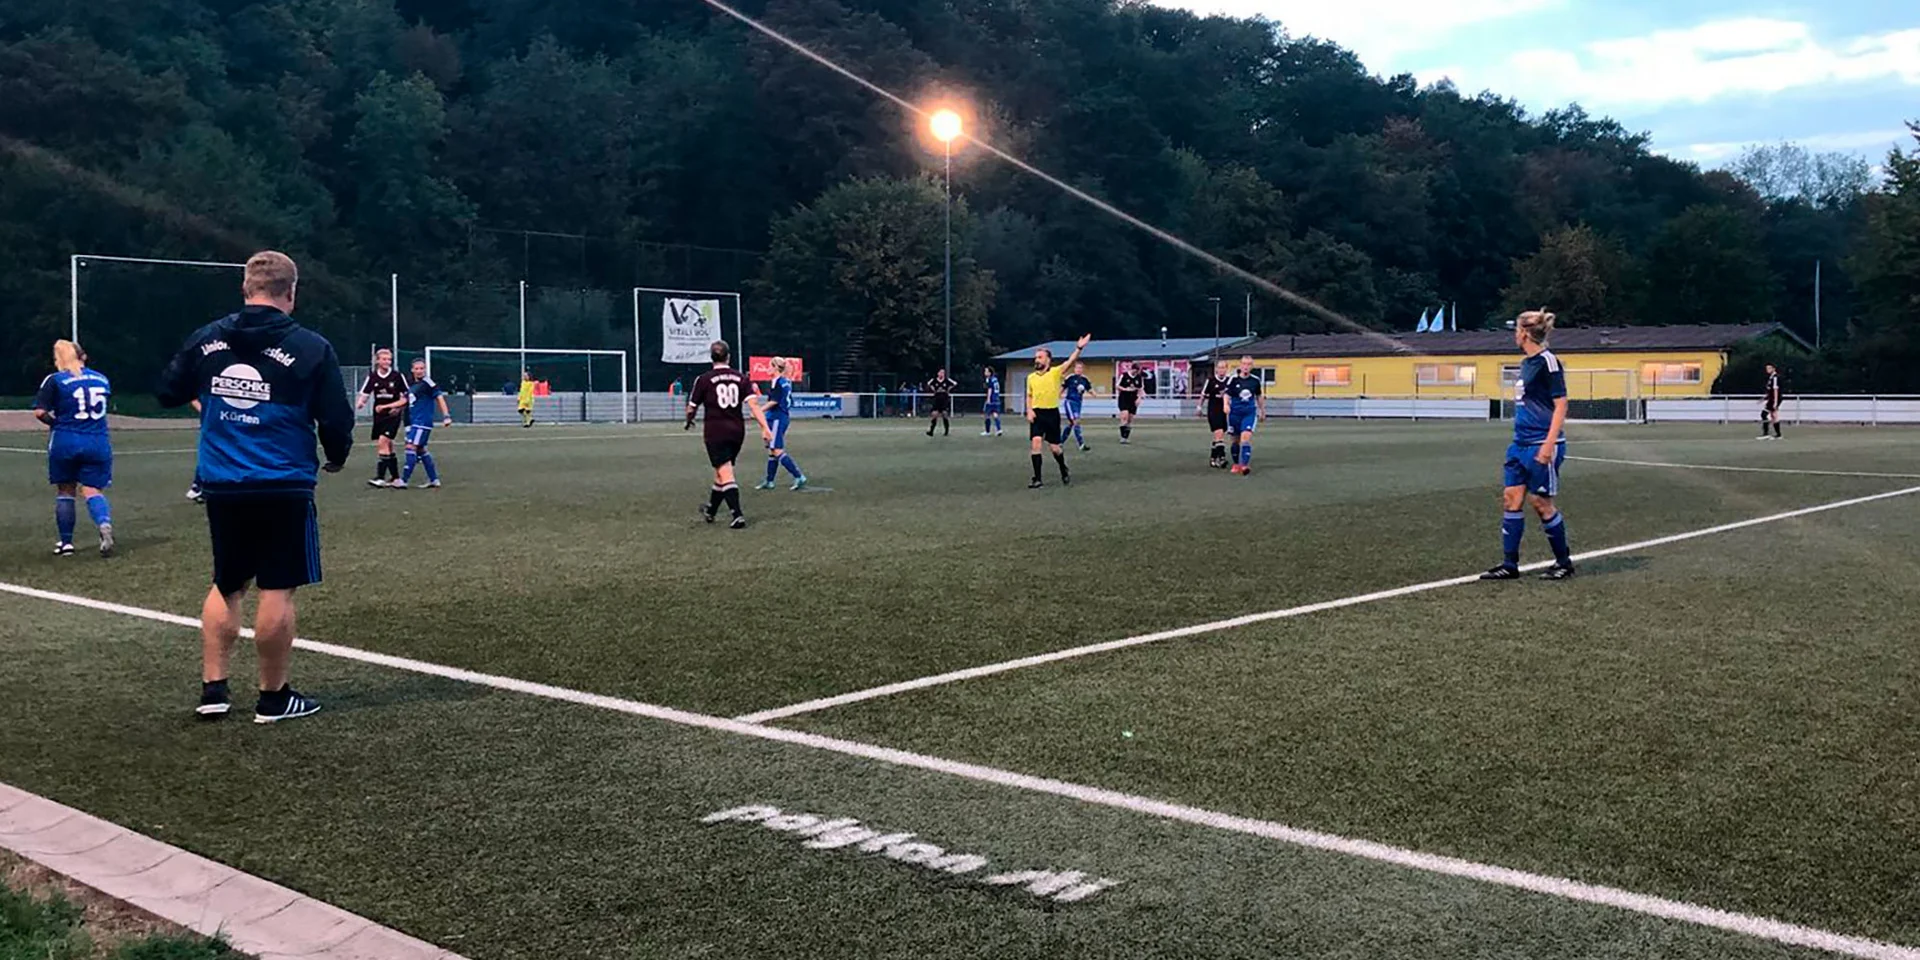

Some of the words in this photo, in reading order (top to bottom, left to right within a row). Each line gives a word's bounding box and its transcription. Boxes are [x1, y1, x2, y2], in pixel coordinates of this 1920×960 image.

[261, 347, 296, 367] esfeld
[211, 376, 271, 394] PERSCHKE
[72, 386, 107, 420] 15
[716, 383, 739, 409] 80
[219, 410, 260, 425] Kürten
